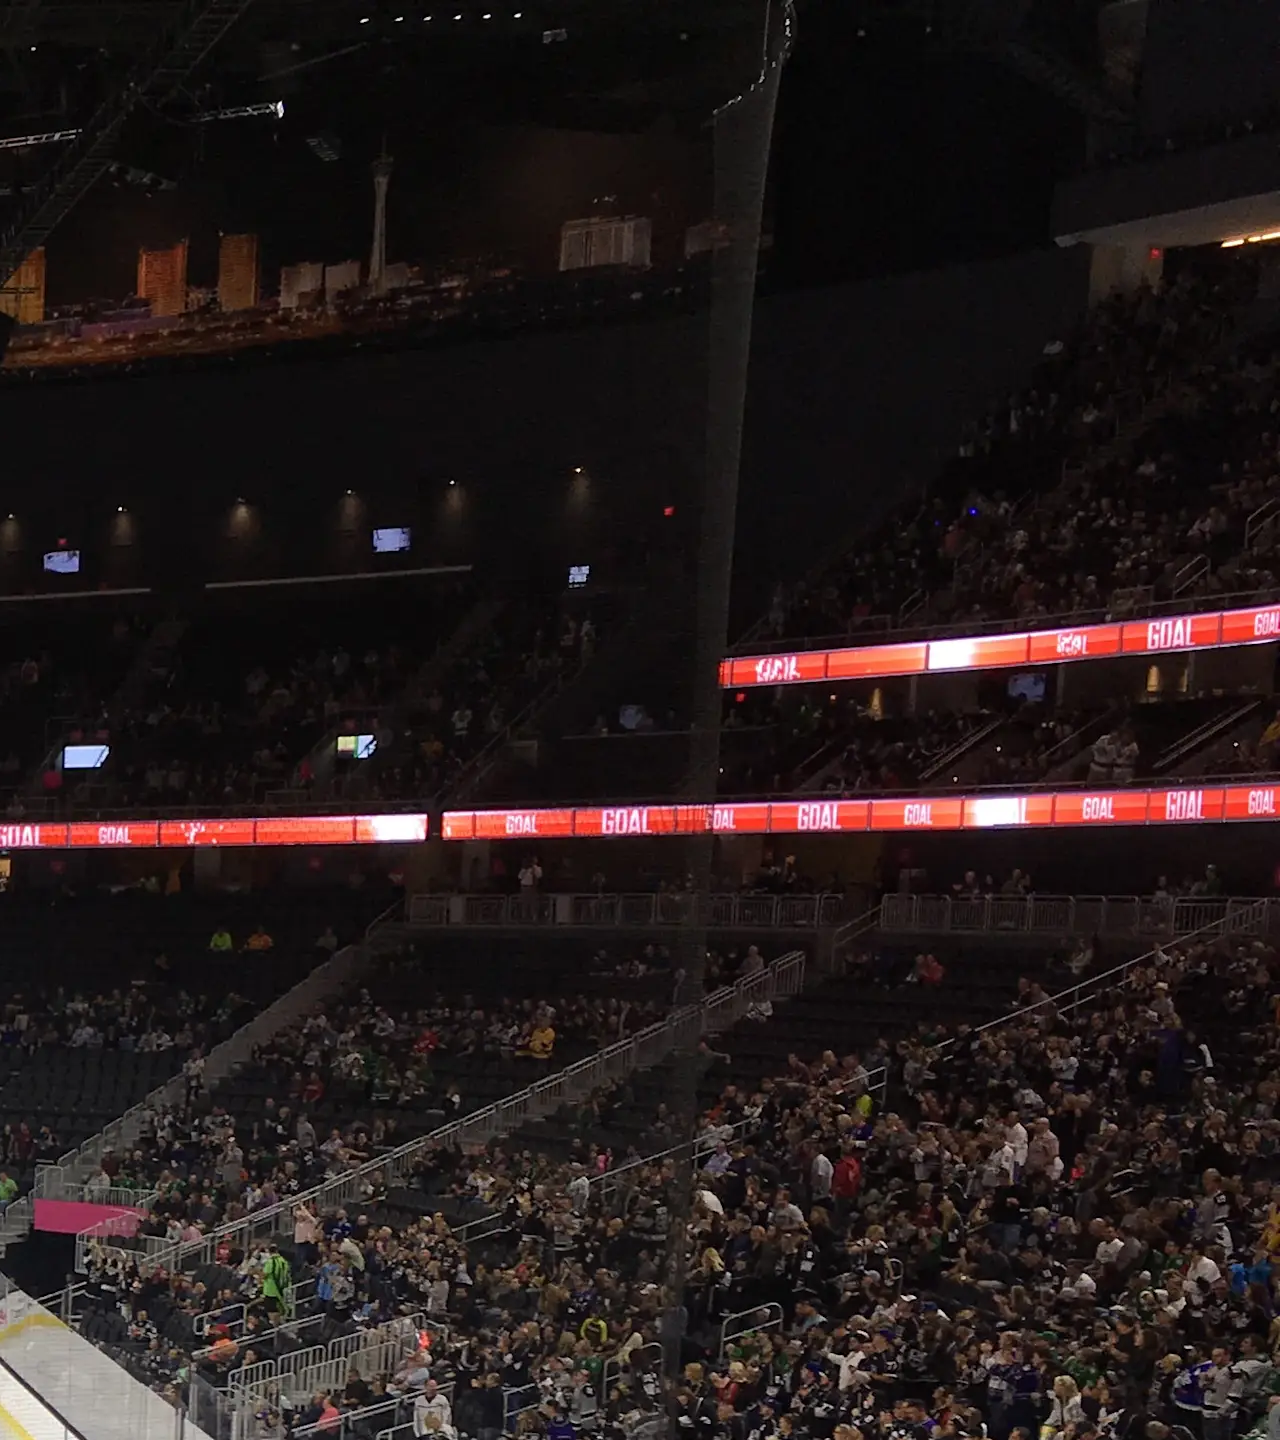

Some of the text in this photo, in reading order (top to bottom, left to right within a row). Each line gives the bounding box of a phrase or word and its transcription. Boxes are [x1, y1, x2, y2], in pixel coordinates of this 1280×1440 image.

[1147, 619, 1196, 650] GOAL
[1253, 611, 1280, 636] GOAL
[903, 804, 933, 826] GOAL
[1082, 797, 1115, 820] GOAL
[1165, 790, 1206, 820] GOAL
[1247, 790, 1276, 815] GOAL
[505, 815, 539, 833] GOAL
[601, 808, 652, 834] GOAL
[796, 801, 841, 830] GOAL
[98, 827, 132, 844] GOAL
